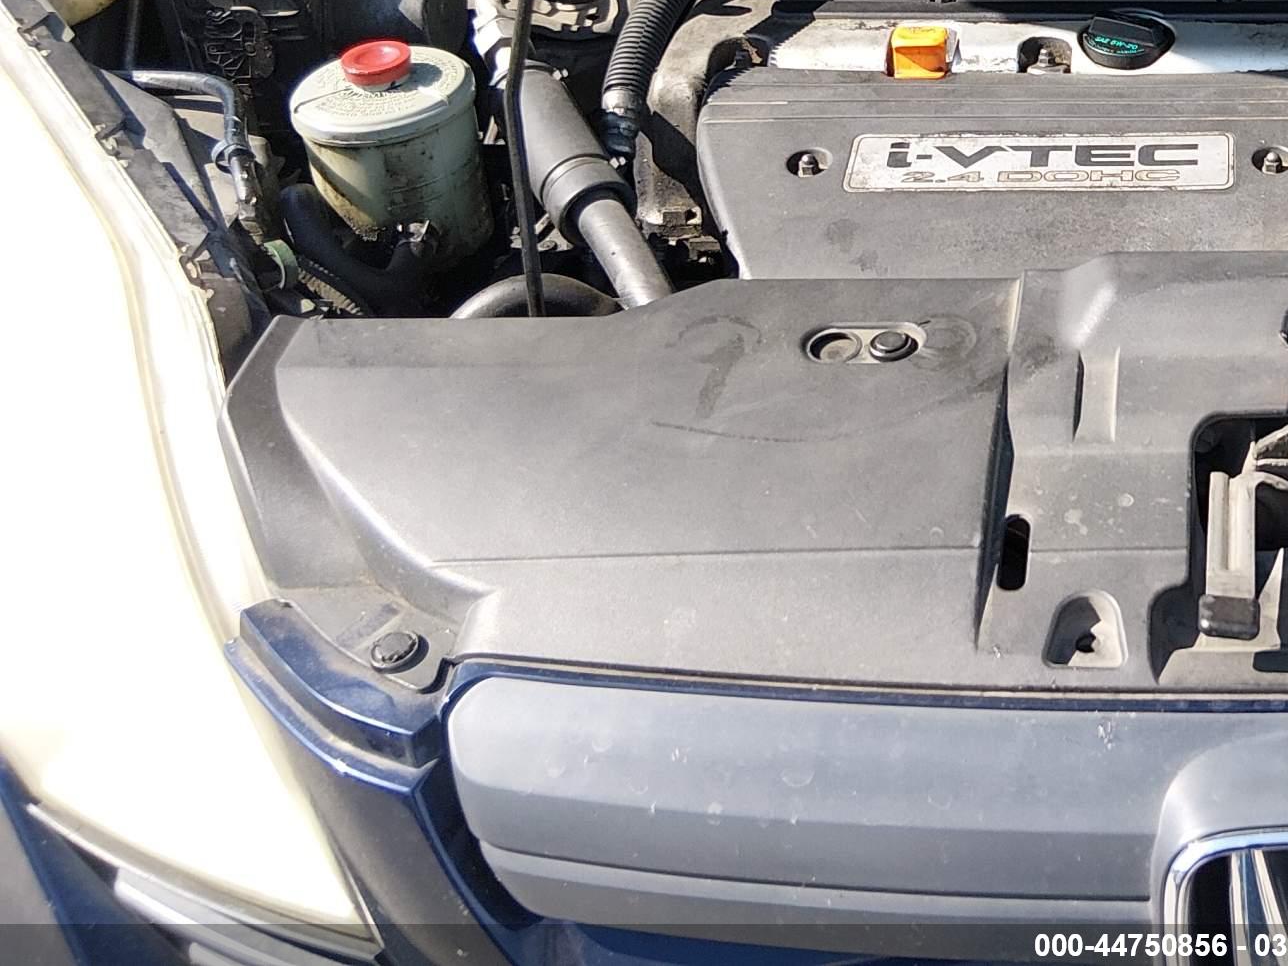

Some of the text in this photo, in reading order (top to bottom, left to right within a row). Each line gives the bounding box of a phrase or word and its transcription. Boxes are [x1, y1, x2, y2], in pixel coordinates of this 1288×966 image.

[886, 142, 1198, 169] i-VTEC
[900, 170, 1180, 183] 2.4 DOHC
